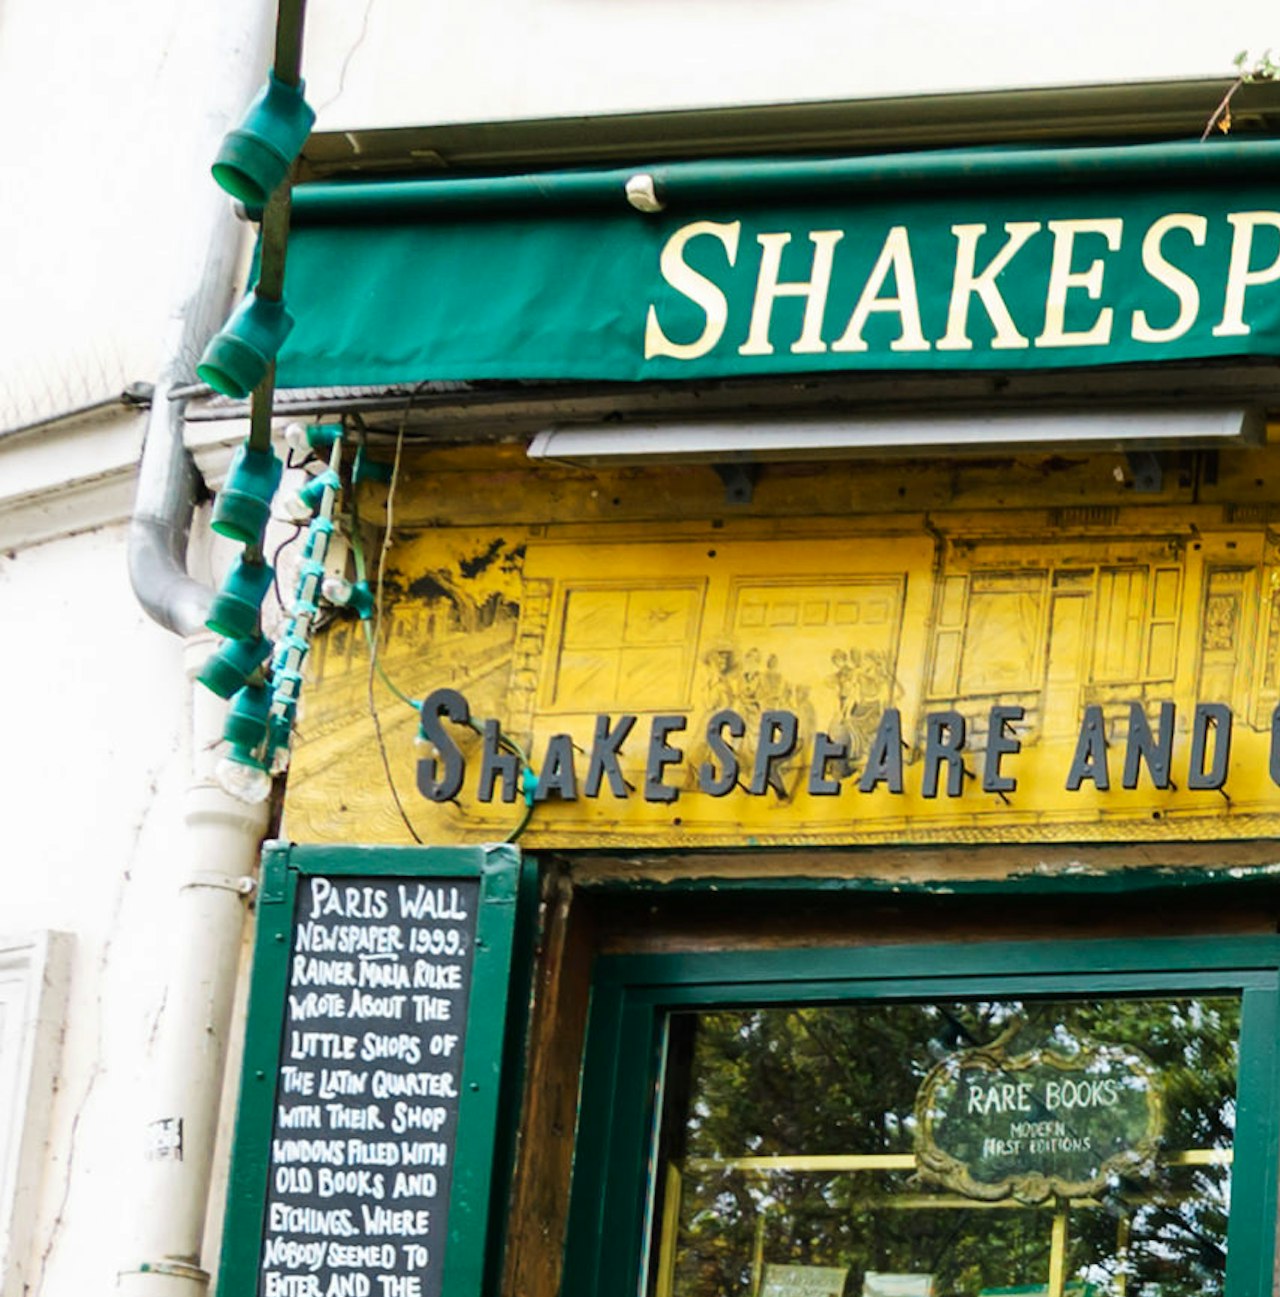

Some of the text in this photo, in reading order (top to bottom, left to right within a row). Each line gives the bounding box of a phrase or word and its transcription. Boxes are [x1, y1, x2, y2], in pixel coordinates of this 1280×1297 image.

[1065, 701, 1233, 791] AND
[309, 877, 468, 921] PARIS WALL
[295, 920, 465, 958] NEWSPAPER 1999.
[291, 954, 462, 990] RAINER MARIA RILKE
[288, 992, 451, 1023] WROTE ABOUT THE
[290, 1030, 459, 1065] LITTLE SHOPS OF
[967, 1079, 1119, 1115] RARE BOOKS
[1010, 1122, 1066, 1138] MODERN
